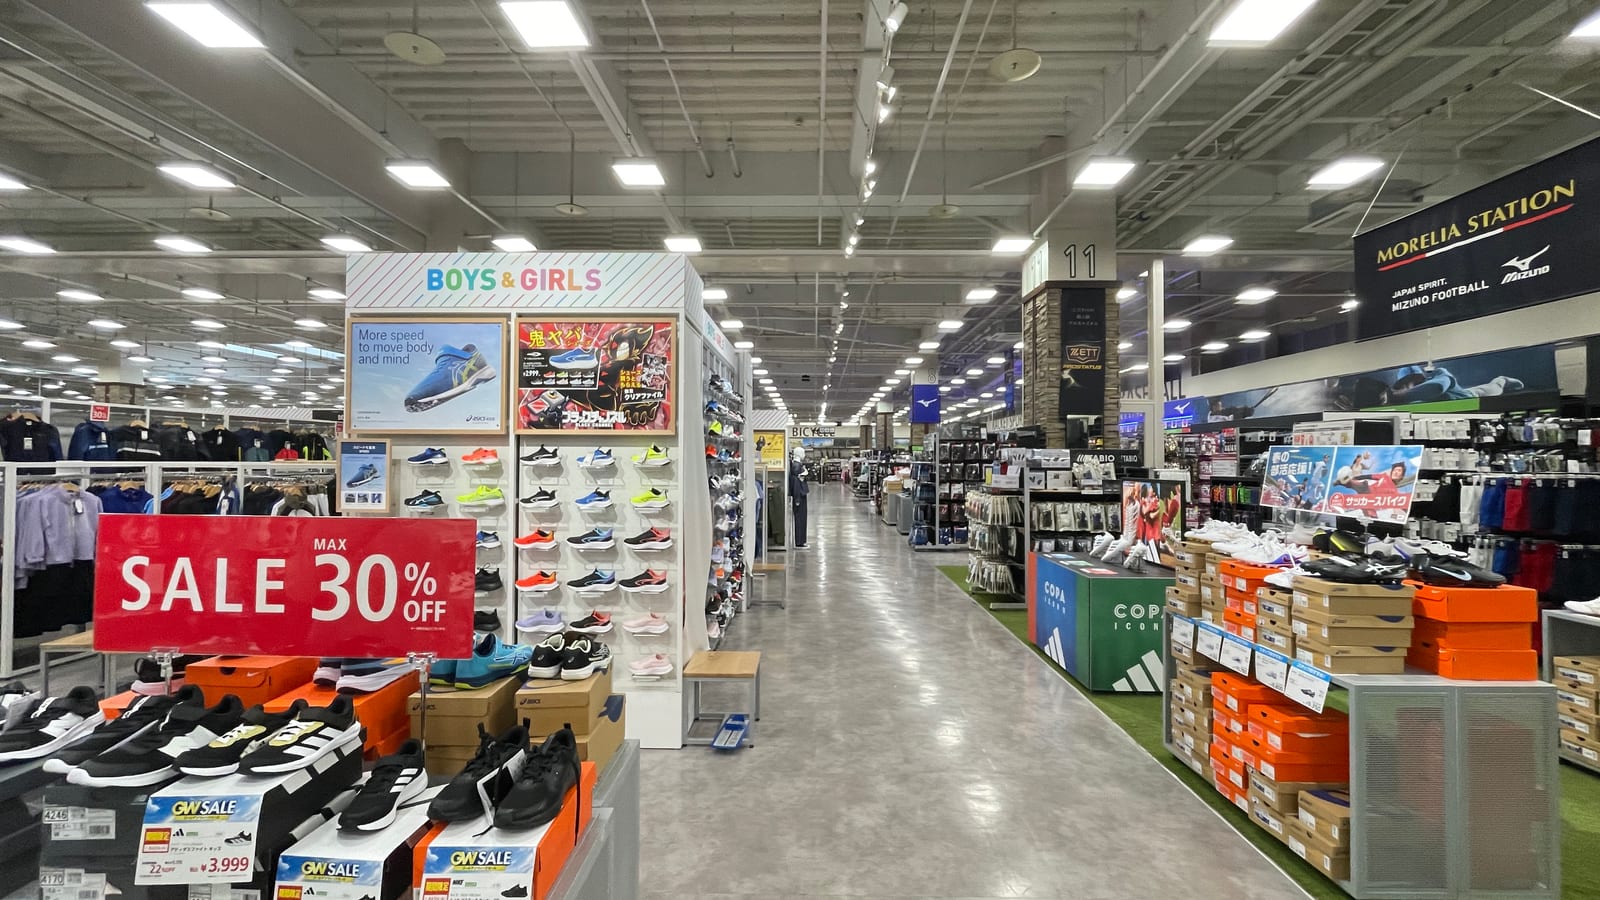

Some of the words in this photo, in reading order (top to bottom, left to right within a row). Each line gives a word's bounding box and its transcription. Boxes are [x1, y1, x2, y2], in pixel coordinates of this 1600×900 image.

[1377, 223, 1461, 264] MORELIA
[1468, 179, 1575, 233] STATION
[1064, 244, 1096, 278] 11
[427, 268, 496, 291] BOYS
[501, 271, 515, 288] &
[520, 268, 602, 291] GIRLS
[1418, 278, 1448, 291] SPIRIT.
[1392, 295, 1429, 312] MIZUNO
[1432, 280, 1489, 302] FOOTBALL
[358, 329, 387, 341] More
[391, 329, 424, 342] speed
[529, 327, 582, 348] 鬼ヤバ
[358, 342, 370, 352] to
[373, 344, 403, 353] move
[407, 341, 434, 354] body
[1070, 347, 1098, 356] ZETT
[358, 354, 379, 365] and
[383, 354, 410, 365] mind
[624, 391, 663, 400] クリアファイル
[1346, 496, 1407, 506] サッカースパイク
[313, 538, 347, 551] MAX
[121, 555, 286, 614] SALE
[1044, 581, 1065, 603] COPA
[403, 600, 447, 622] OFF
[1114, 604, 1163, 619] COP
[1114, 622, 1160, 631] ICON
[172, 800, 201, 816] GW
[200, 800, 237, 815] SALE
[201, 856, 249, 873] ¥3,999
[450, 851, 478, 865] GW
[477, 851, 512, 865] SALE
[302, 861, 328, 875] GW
[327, 862, 360, 877] SALE
